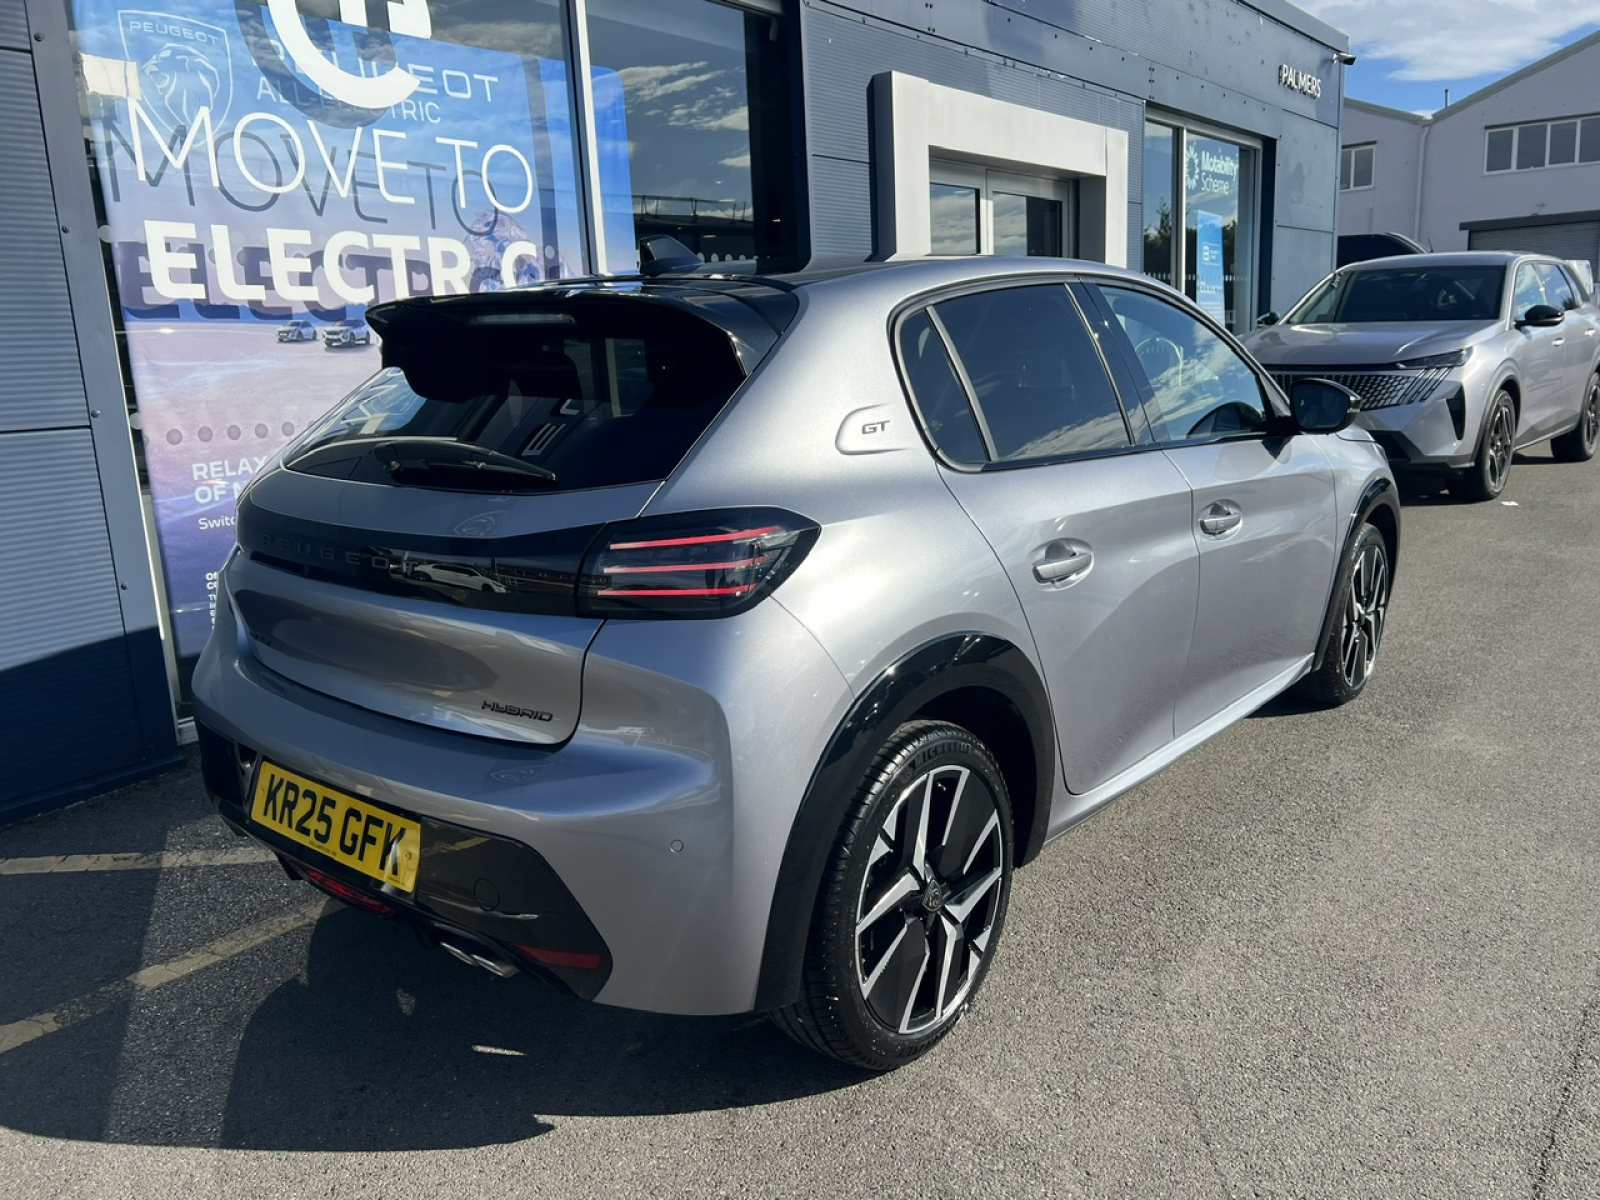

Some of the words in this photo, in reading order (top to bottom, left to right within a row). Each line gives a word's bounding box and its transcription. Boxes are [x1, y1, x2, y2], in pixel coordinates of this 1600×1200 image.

[129, 20, 218, 46] PEUGEOT
[1282, 63, 1321, 99] PALMERS
[127, 98, 415, 205] MOVE
[435, 136, 533, 214] TO
[1200, 150, 1237, 182] Motability
[1200, 171, 1230, 195] Scheme
[861, 419, 891, 435] GT
[192, 456, 267, 480] RELAX
[195, 484, 227, 504] OF
[481, 700, 553, 722] HYBRID
[263, 773, 337, 844] KR25
[339, 806, 407, 876] GFK
